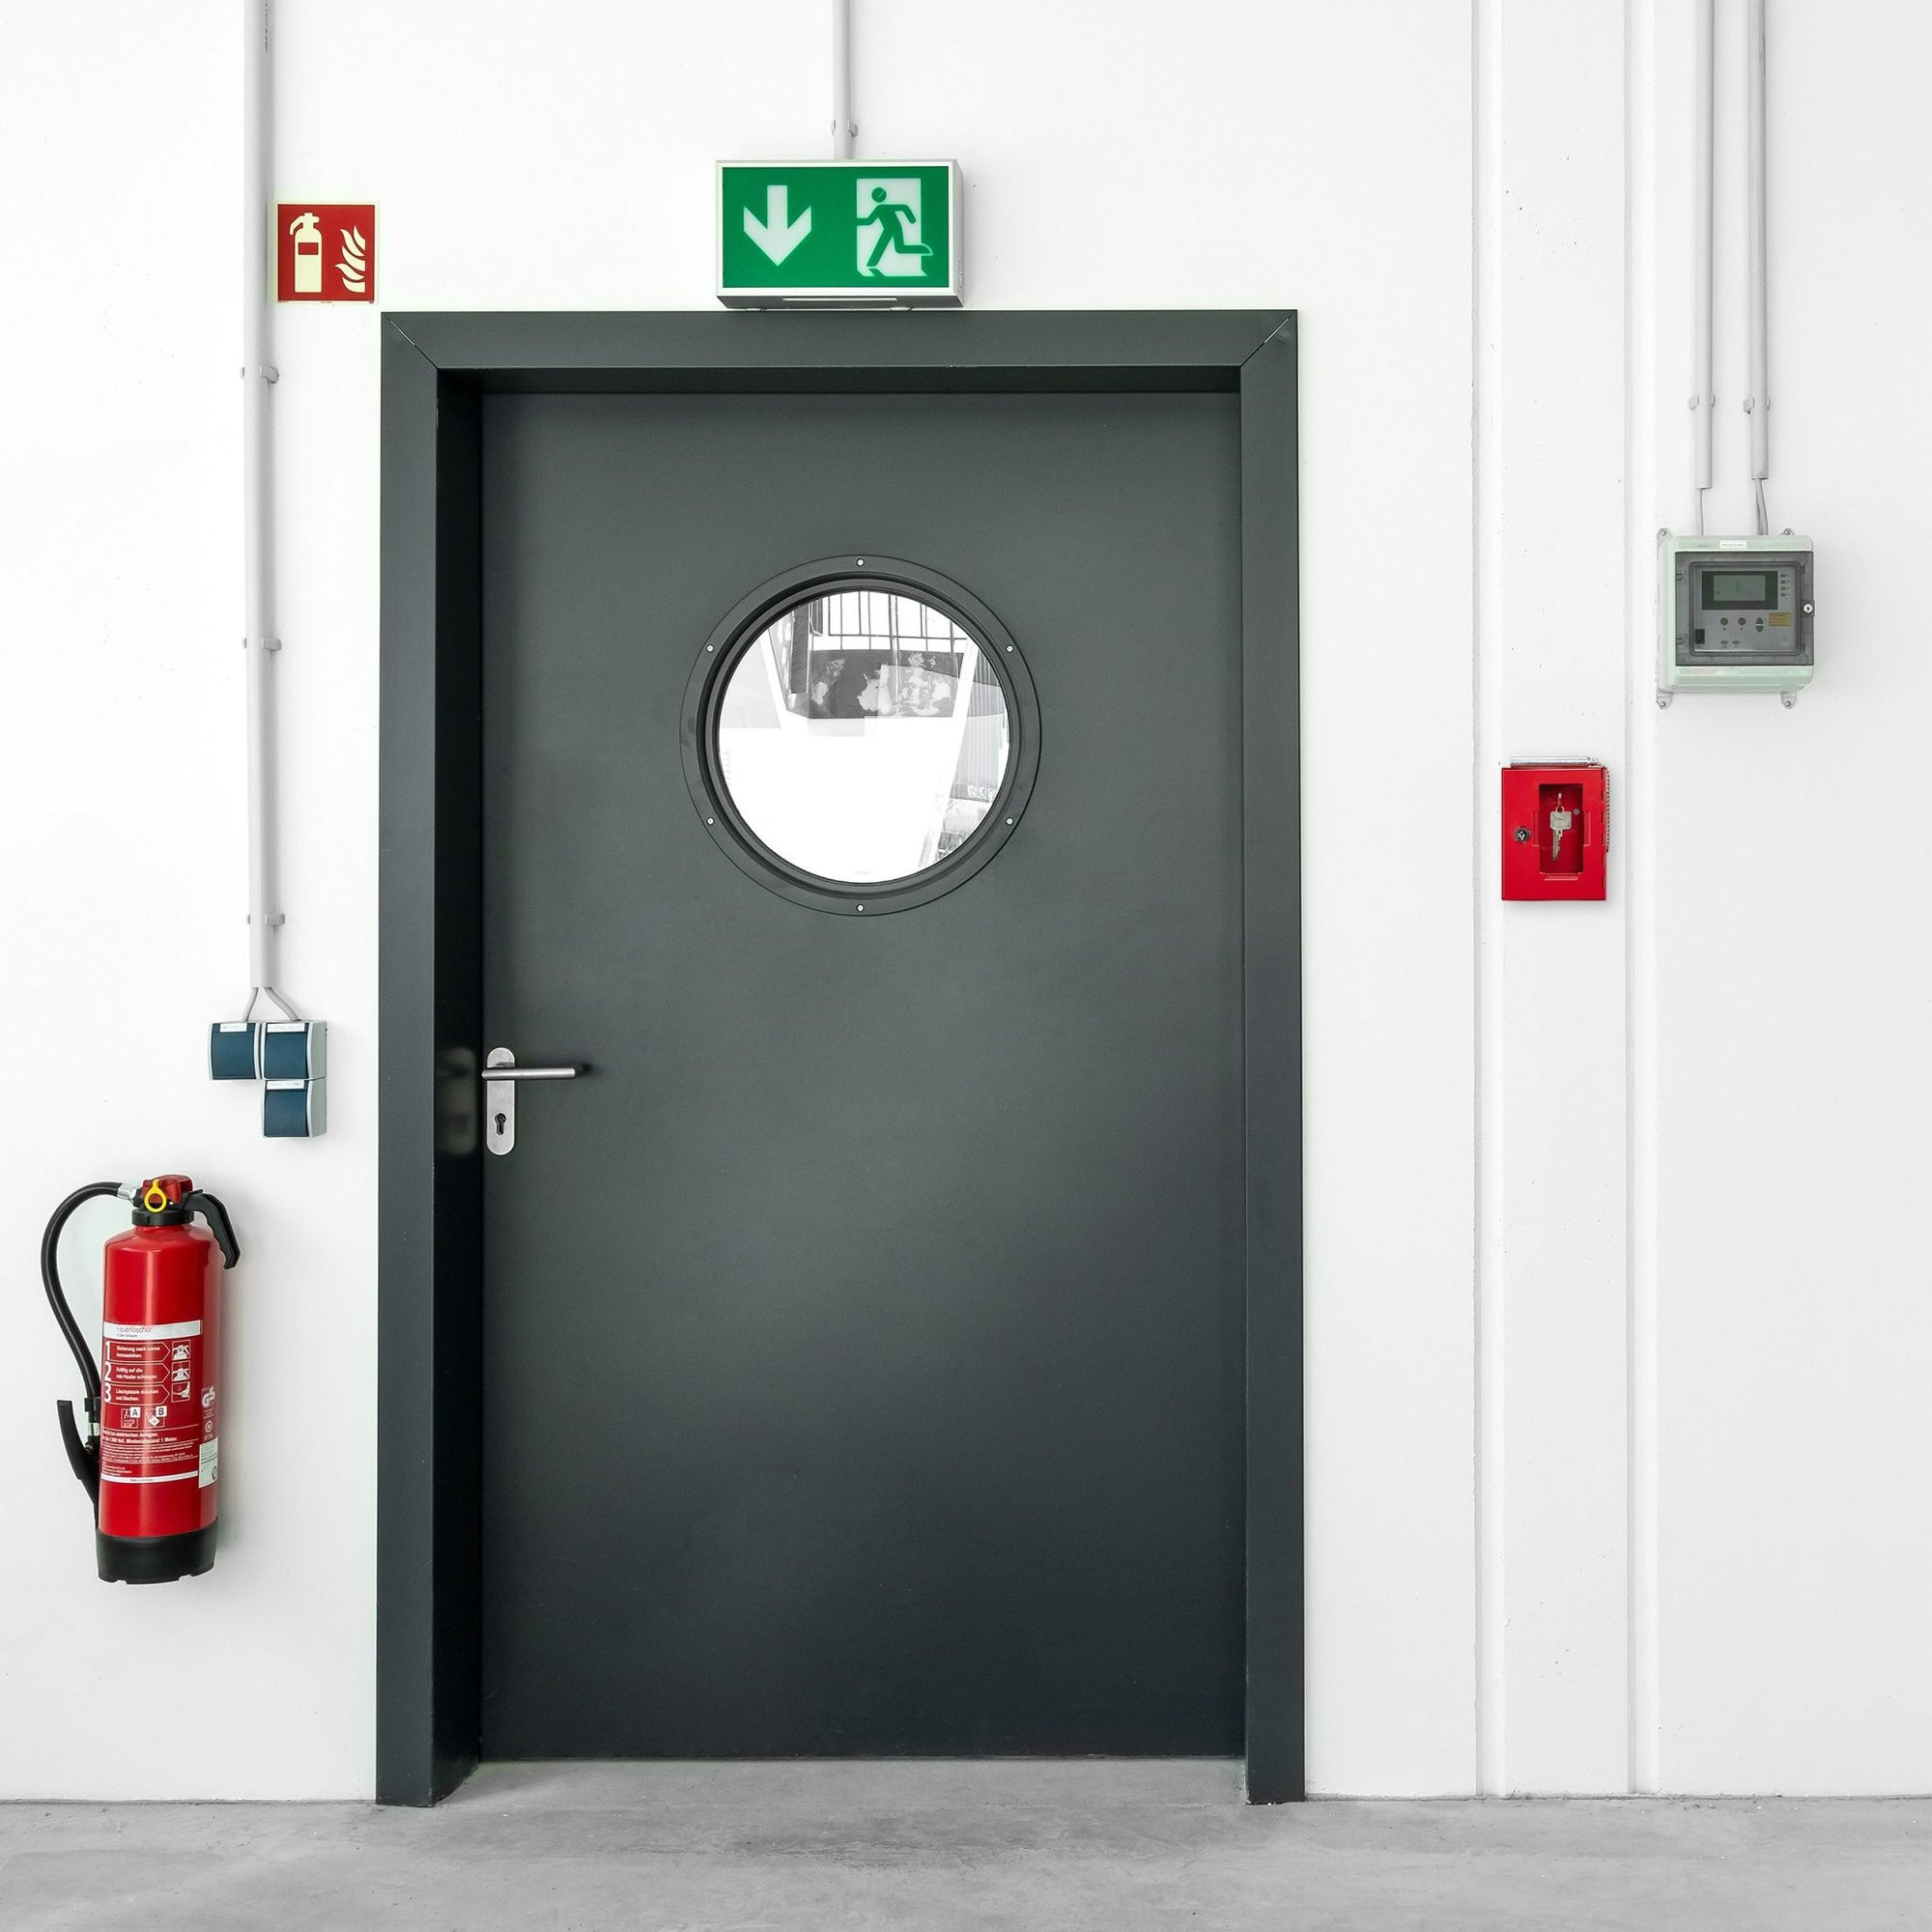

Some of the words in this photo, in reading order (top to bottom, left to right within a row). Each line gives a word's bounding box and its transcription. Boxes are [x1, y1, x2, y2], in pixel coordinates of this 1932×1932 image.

[104, 1341, 111, 1361] 1
[104, 1361, 111, 1381] 2
[104, 1382, 111, 1403] 3
